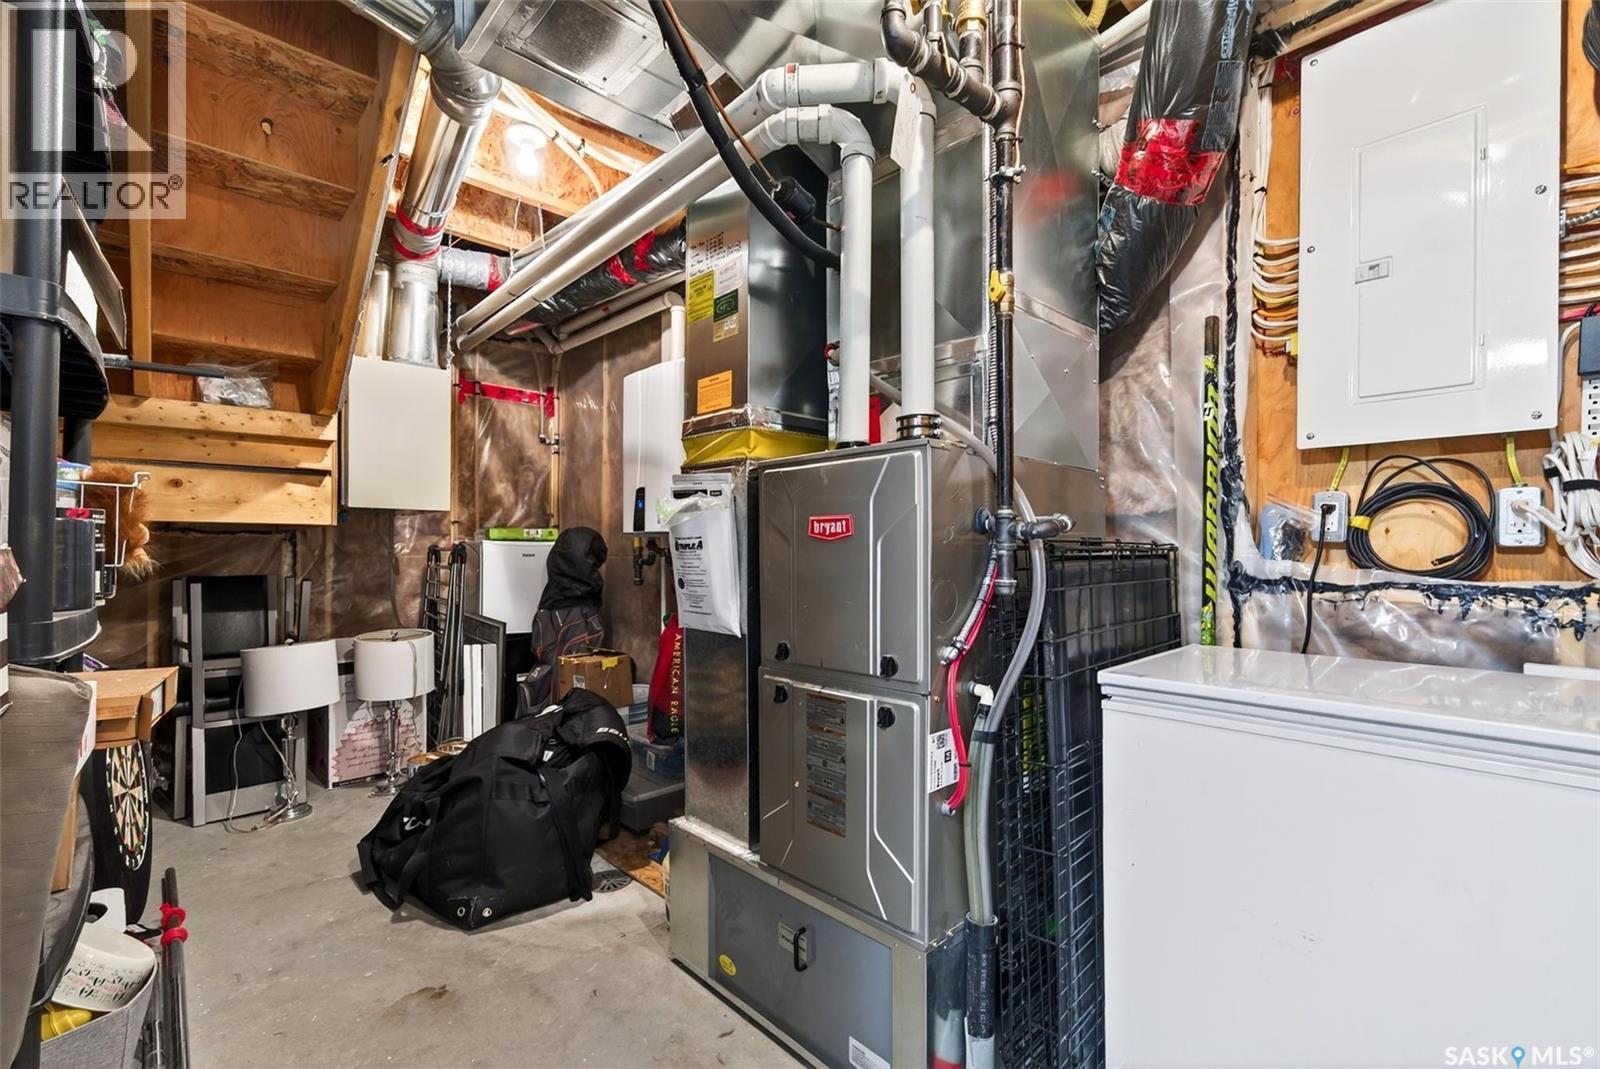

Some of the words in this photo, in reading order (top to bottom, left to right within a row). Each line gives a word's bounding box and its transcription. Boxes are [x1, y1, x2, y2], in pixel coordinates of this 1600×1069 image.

[813, 520, 847, 535] bryant
[672, 633, 683, 694] AMERICAN
[670, 701, 679, 734] EAGLE
